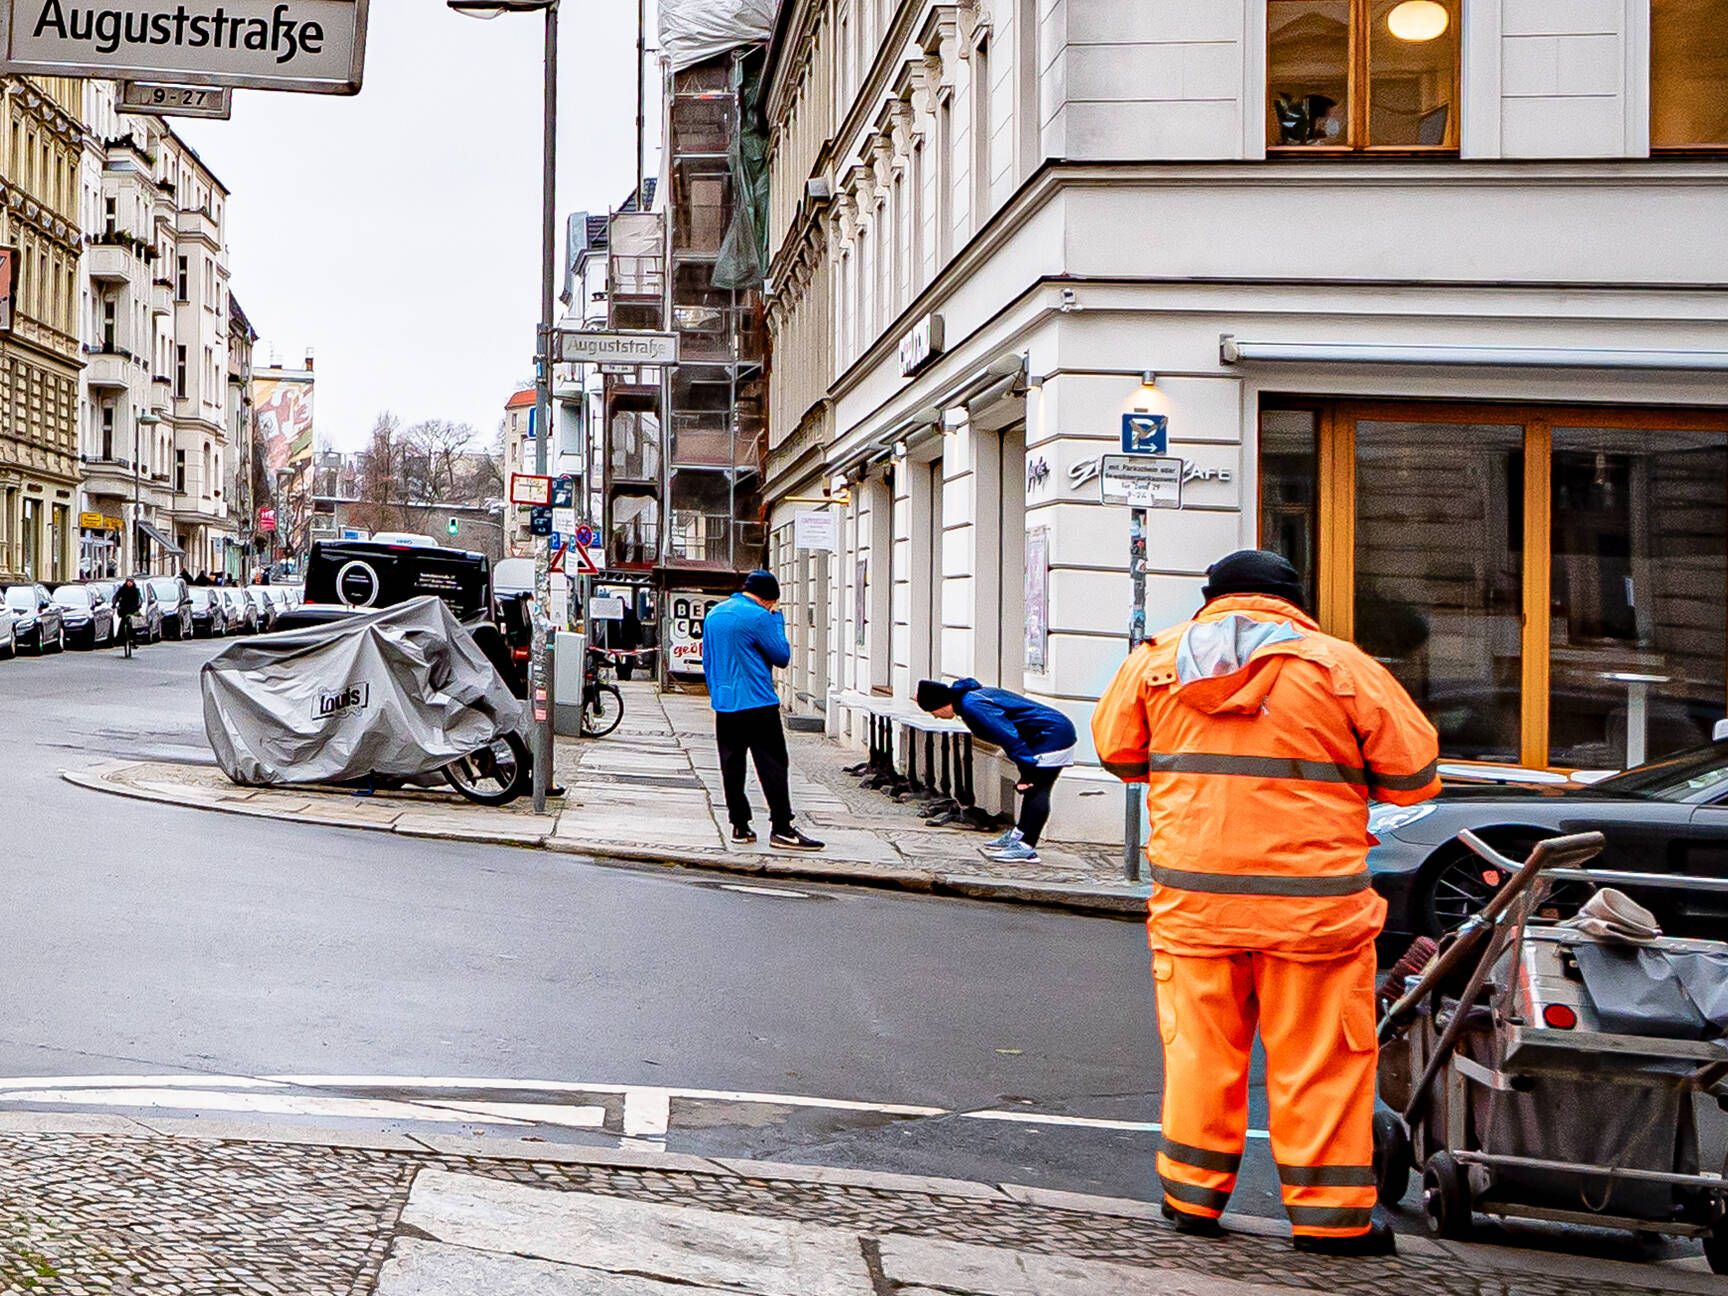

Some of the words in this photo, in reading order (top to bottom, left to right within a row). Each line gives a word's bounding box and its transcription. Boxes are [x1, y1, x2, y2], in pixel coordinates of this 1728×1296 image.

[153, 88, 165, 104] 9
[182, 90, 207, 106] 27
[567, 338, 666, 359] Auguststraße
[677, 603, 713, 617] BE
[677, 620, 702, 634] CA
[319, 688, 361, 715] Louis
